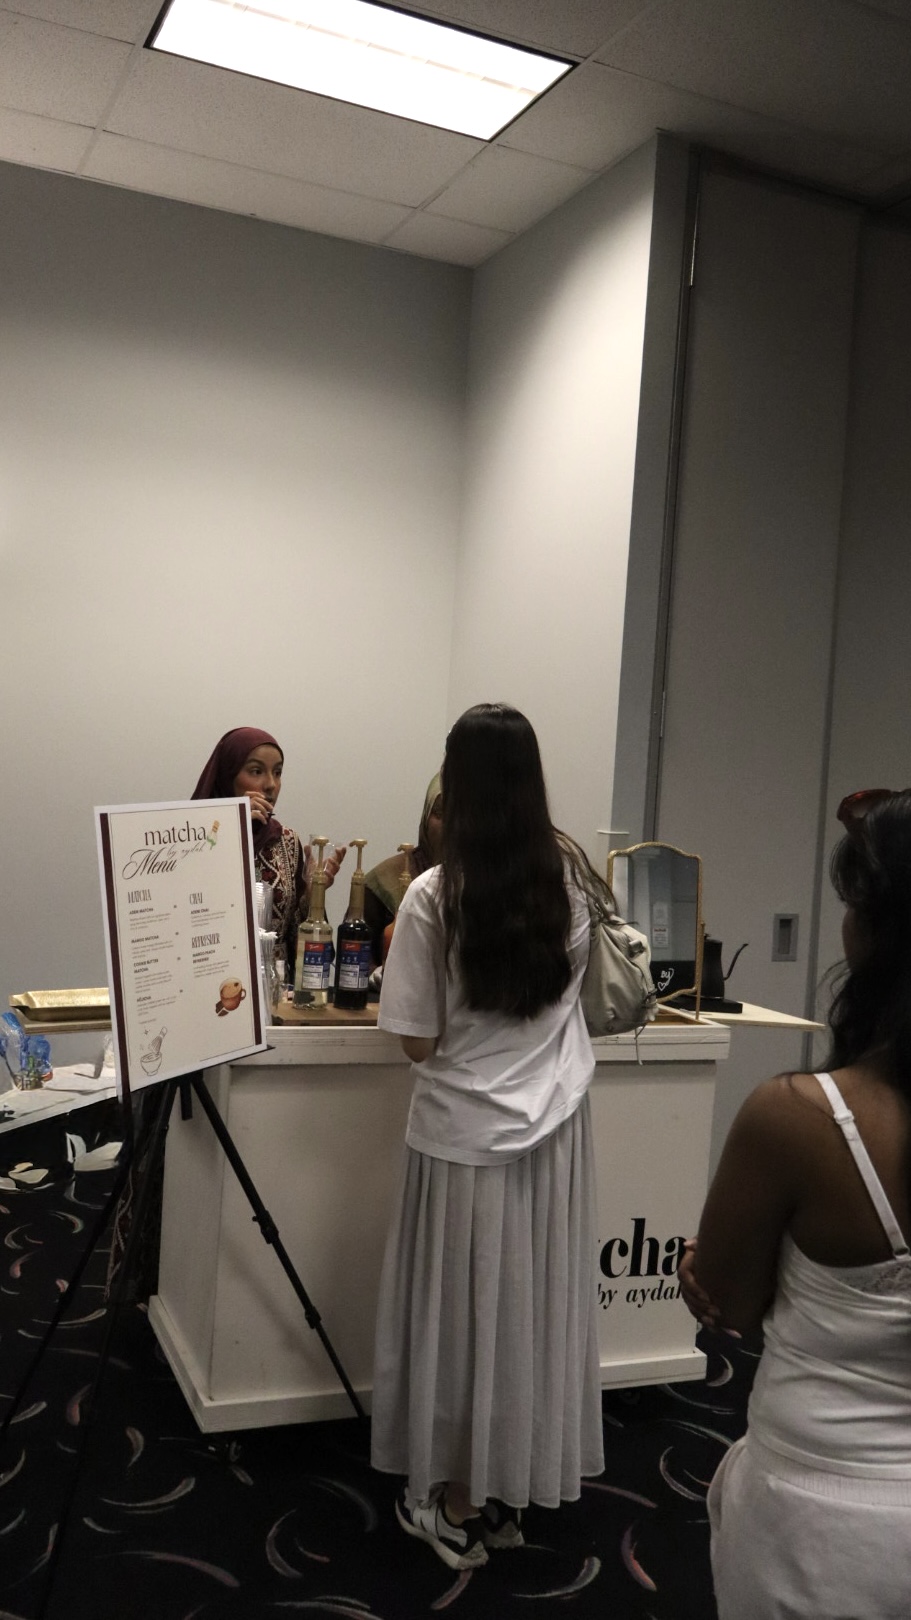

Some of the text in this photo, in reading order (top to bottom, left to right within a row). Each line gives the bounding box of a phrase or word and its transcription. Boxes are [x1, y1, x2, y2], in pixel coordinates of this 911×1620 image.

[144, 821, 206, 846] matcha
[122, 847, 178, 880] Menu
[127, 889, 152, 904] MATCHA
[191, 932, 221, 949] REFRESHER
[598, 1217, 686, 1278] cha
